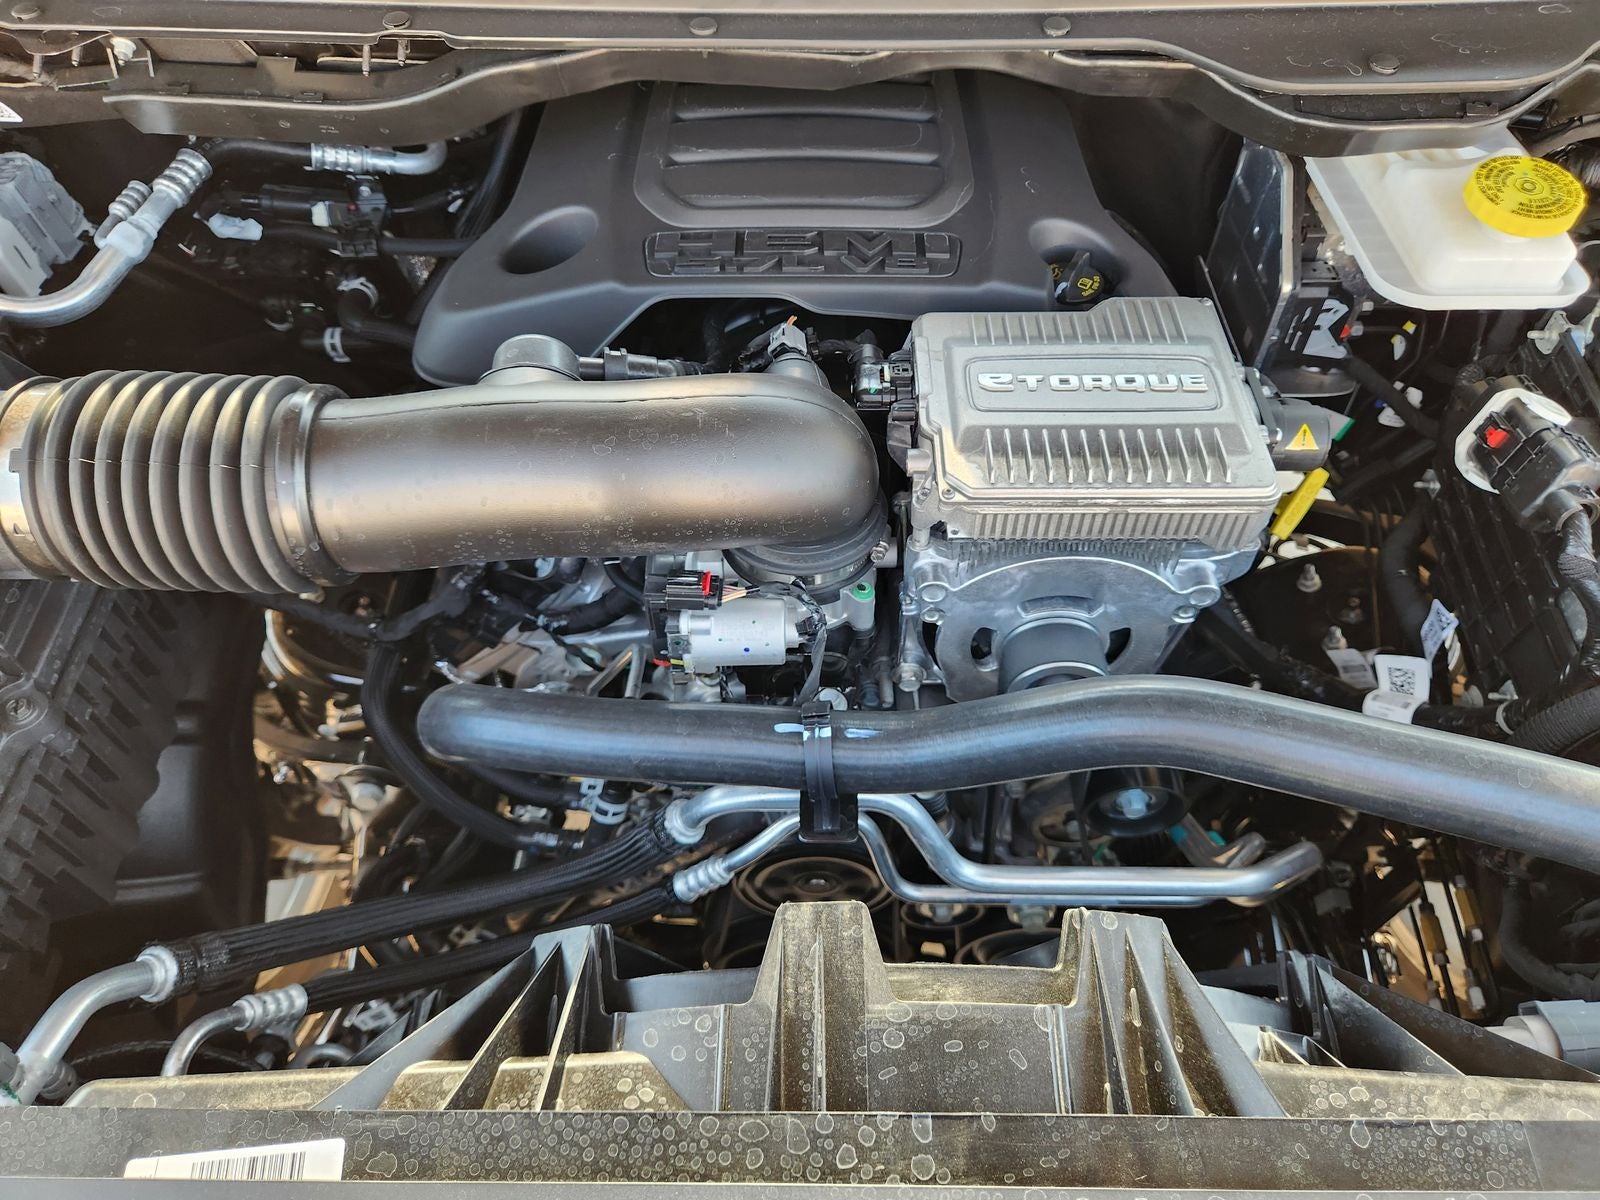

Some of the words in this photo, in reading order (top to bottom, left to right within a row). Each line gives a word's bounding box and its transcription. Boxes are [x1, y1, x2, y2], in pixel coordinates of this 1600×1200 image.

[653, 230, 950, 259] HEMI
[673, 254, 825, 274] 5.7L
[840, 255, 930, 274] V8
